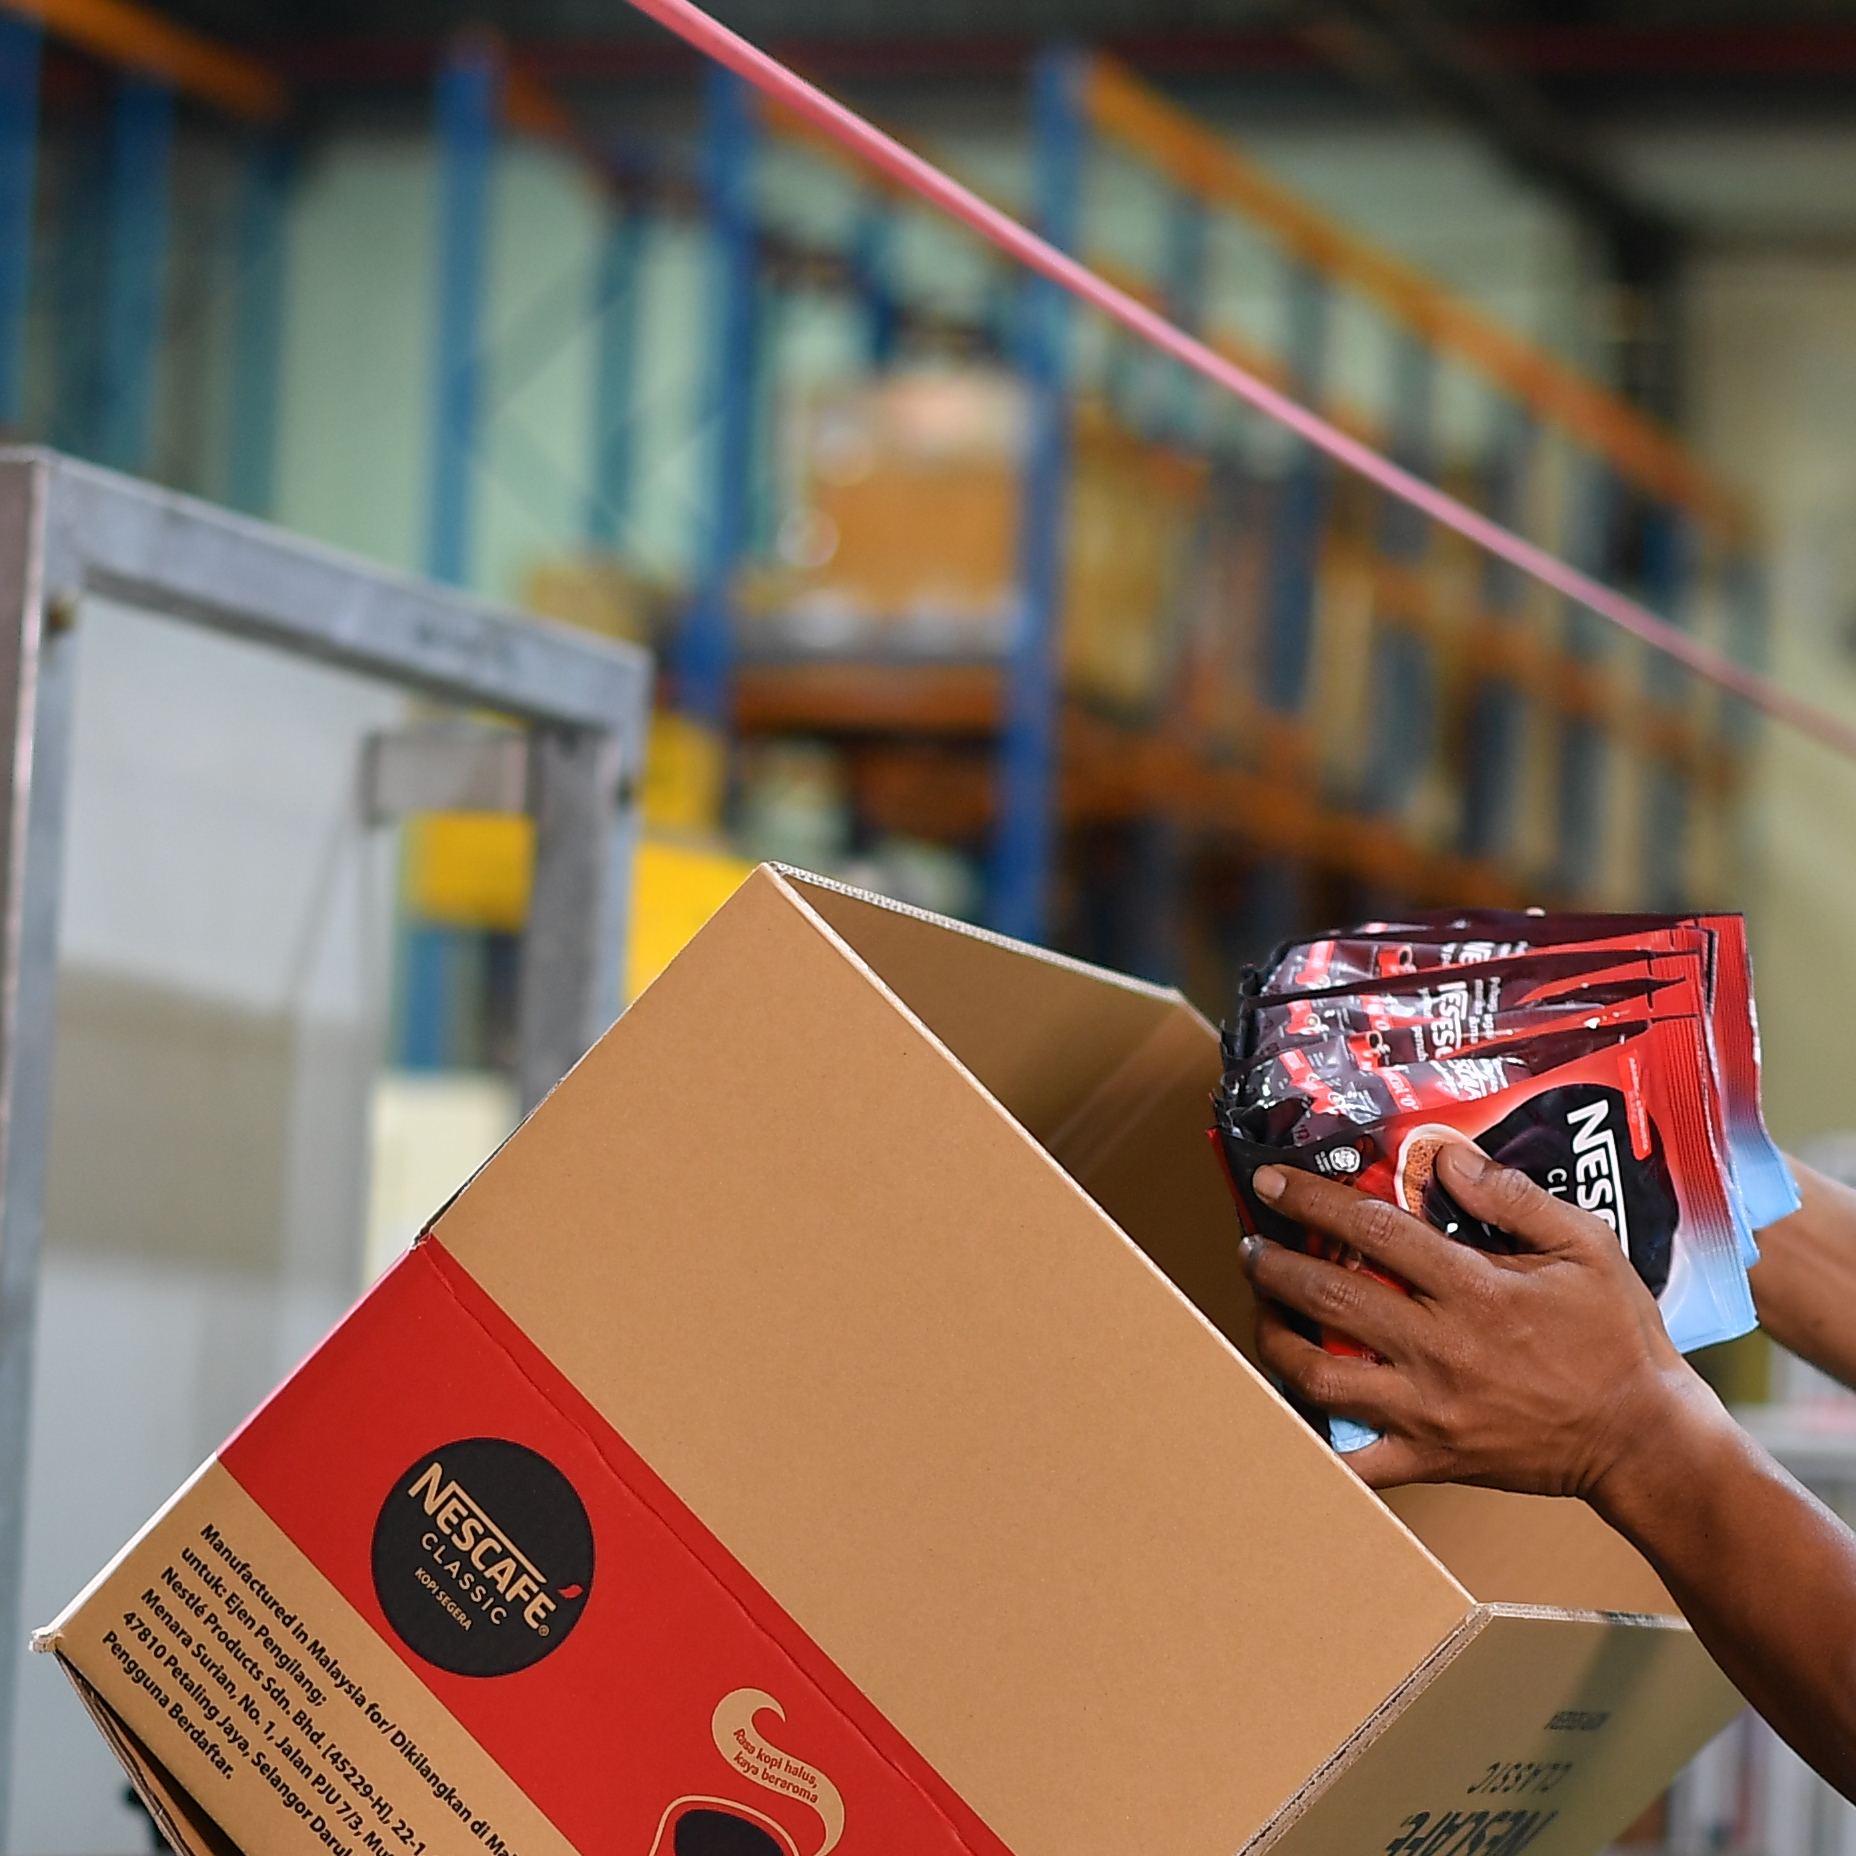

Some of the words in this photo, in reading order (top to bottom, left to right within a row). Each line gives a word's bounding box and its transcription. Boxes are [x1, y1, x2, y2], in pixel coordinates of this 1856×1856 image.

[180, 1546, 228, 1599] untuk:
[222, 1590, 257, 1631] Ejen
[252, 1623, 327, 1707] Pengilang;
[413, 1566, 441, 1596] KOPI
[435, 1589, 474, 1632] SEGERA
[420, 1531, 508, 1625] CLASSIC
[101, 1629, 170, 1709] Pengguna
[166, 1701, 234, 1781] Berdaftar.
[121, 1611, 168, 1660] 47810
[161, 1653, 221, 1722] Petaling
[214, 1714, 251, 1758] Jaya,
[249, 1750, 314, 1821] Selangor
[139, 1587, 193, 1649] Menara
[189, 1642, 238, 1701] Surian,
[236, 1692, 261, 1727] No.
[262, 1719, 276, 1742] 1,
[273, 1735, 314, 1780] Jalan
[309, 1772, 342, 1805] PJU
[334, 1799, 364, 1837] 7/3,
[159, 1564, 209, 1619] Nestlé
[201, 1611, 265, 1682] Products
[259, 1675, 291, 1716] Sdn.
[290, 1708, 326, 1751] Bhd.
[320, 1742, 394, 1825] [45229-H],
[198, 1522, 298, 1629] Manufactured
[290, 1621, 309, 1645] in
[305, 1638, 367, 1709] Malaysia
[363, 1701, 397, 1735] for/
[388, 1729, 472, 1823] Dikilangkan
[469, 1819, 491, 1840] di
[733, 1728, 756, 1755] Rasa
[755, 1747, 783, 1770] kopi
[783, 1759, 818, 1789] halus,
[733, 1750, 759, 1776] kaya
[761, 1767, 819, 1804] beraroma
